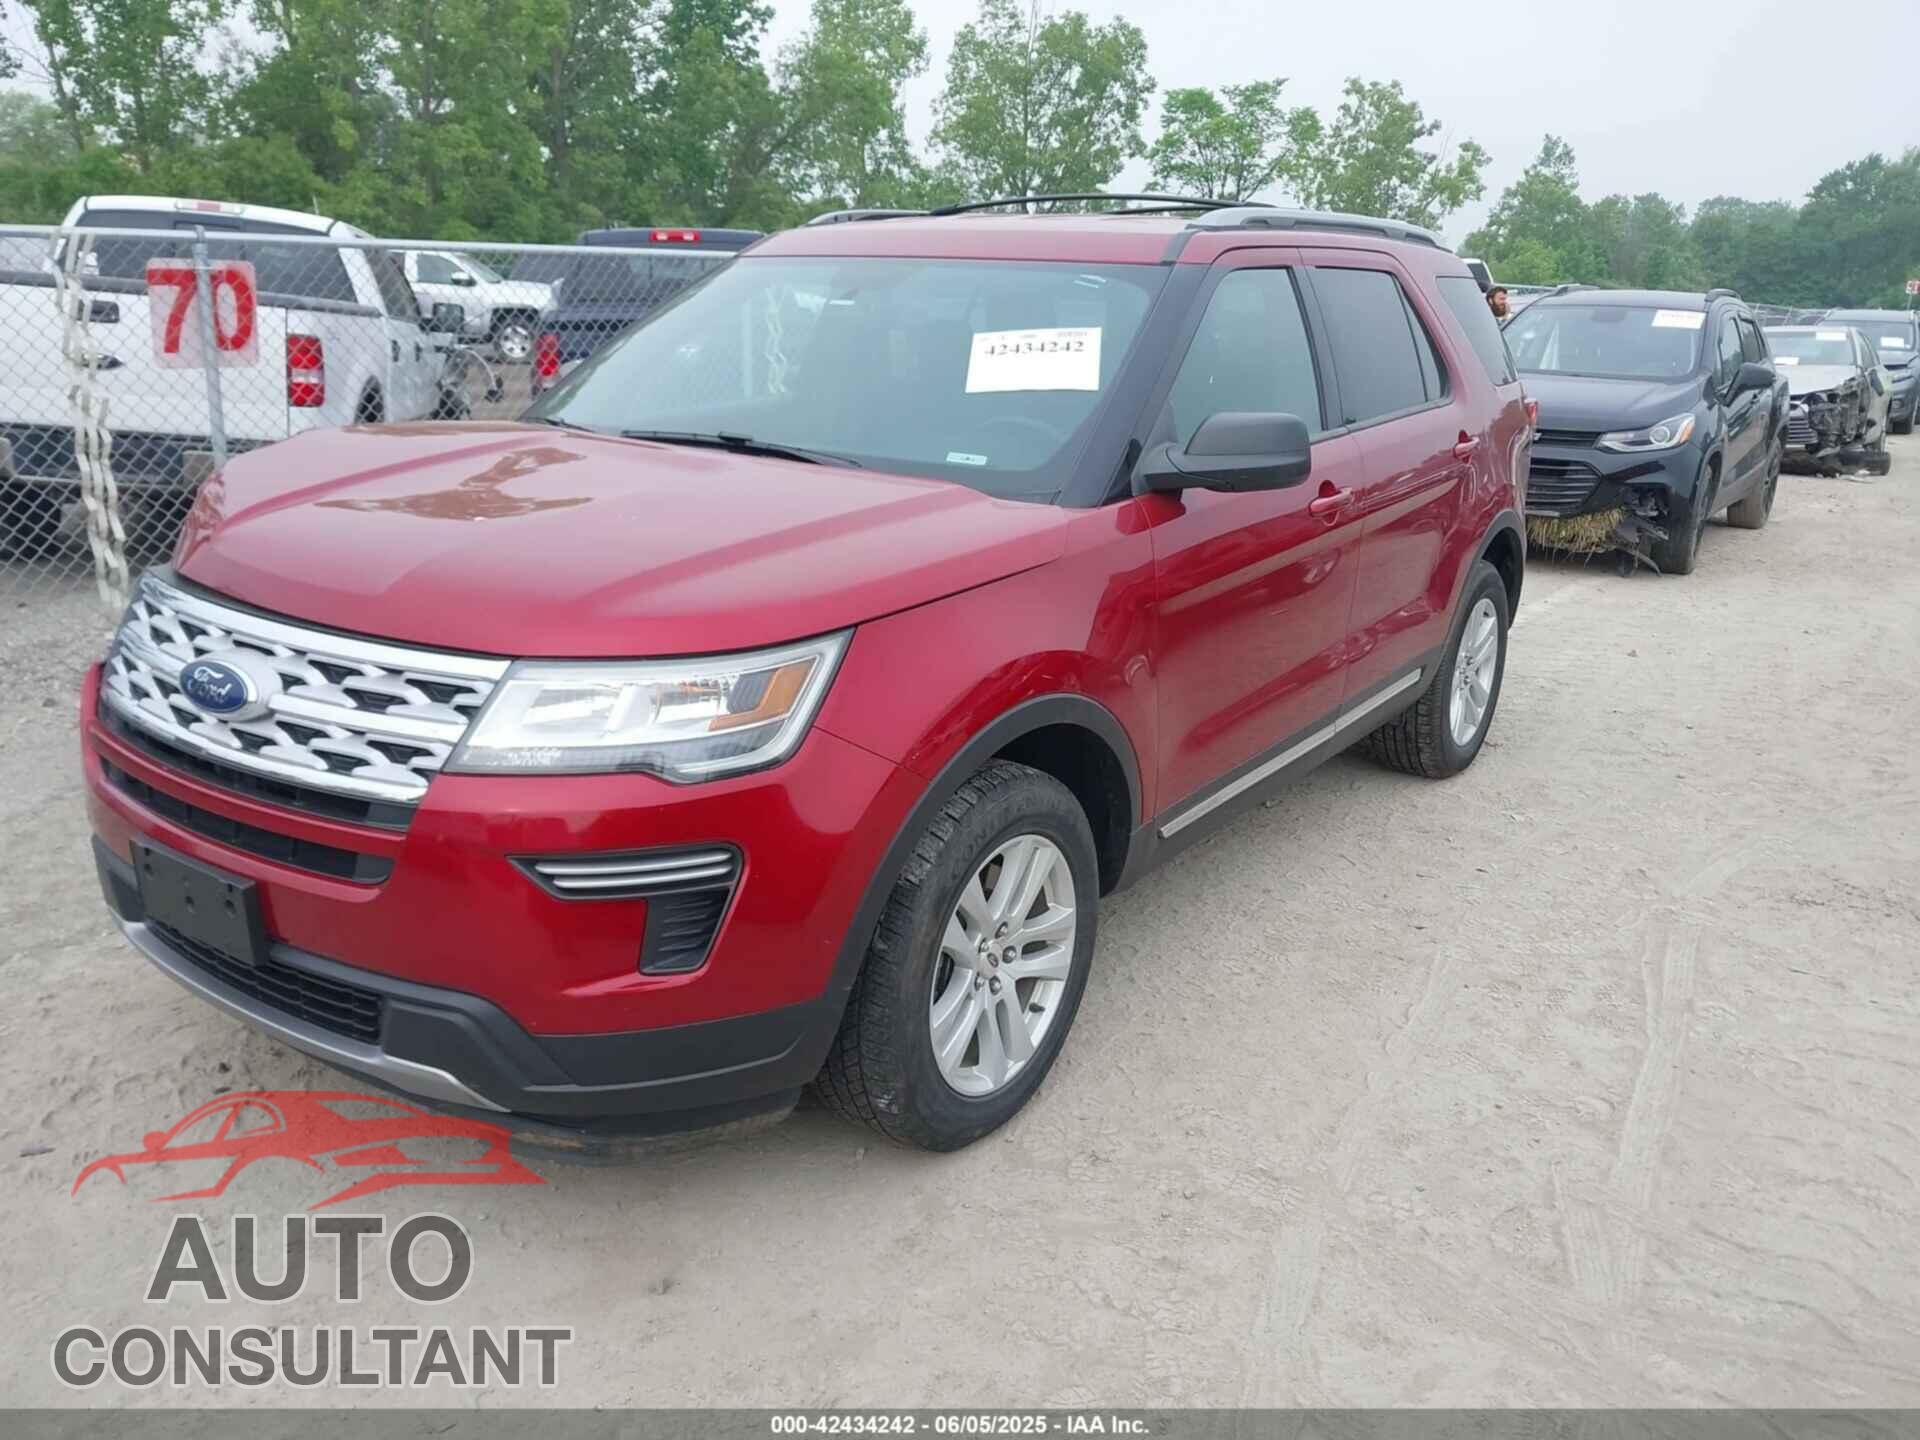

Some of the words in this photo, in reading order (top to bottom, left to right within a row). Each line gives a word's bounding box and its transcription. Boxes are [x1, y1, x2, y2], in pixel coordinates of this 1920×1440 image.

[146, 267, 254, 353] 70
[984, 341, 1084, 355] 42434242
[187, 666, 232, 703] Ford
